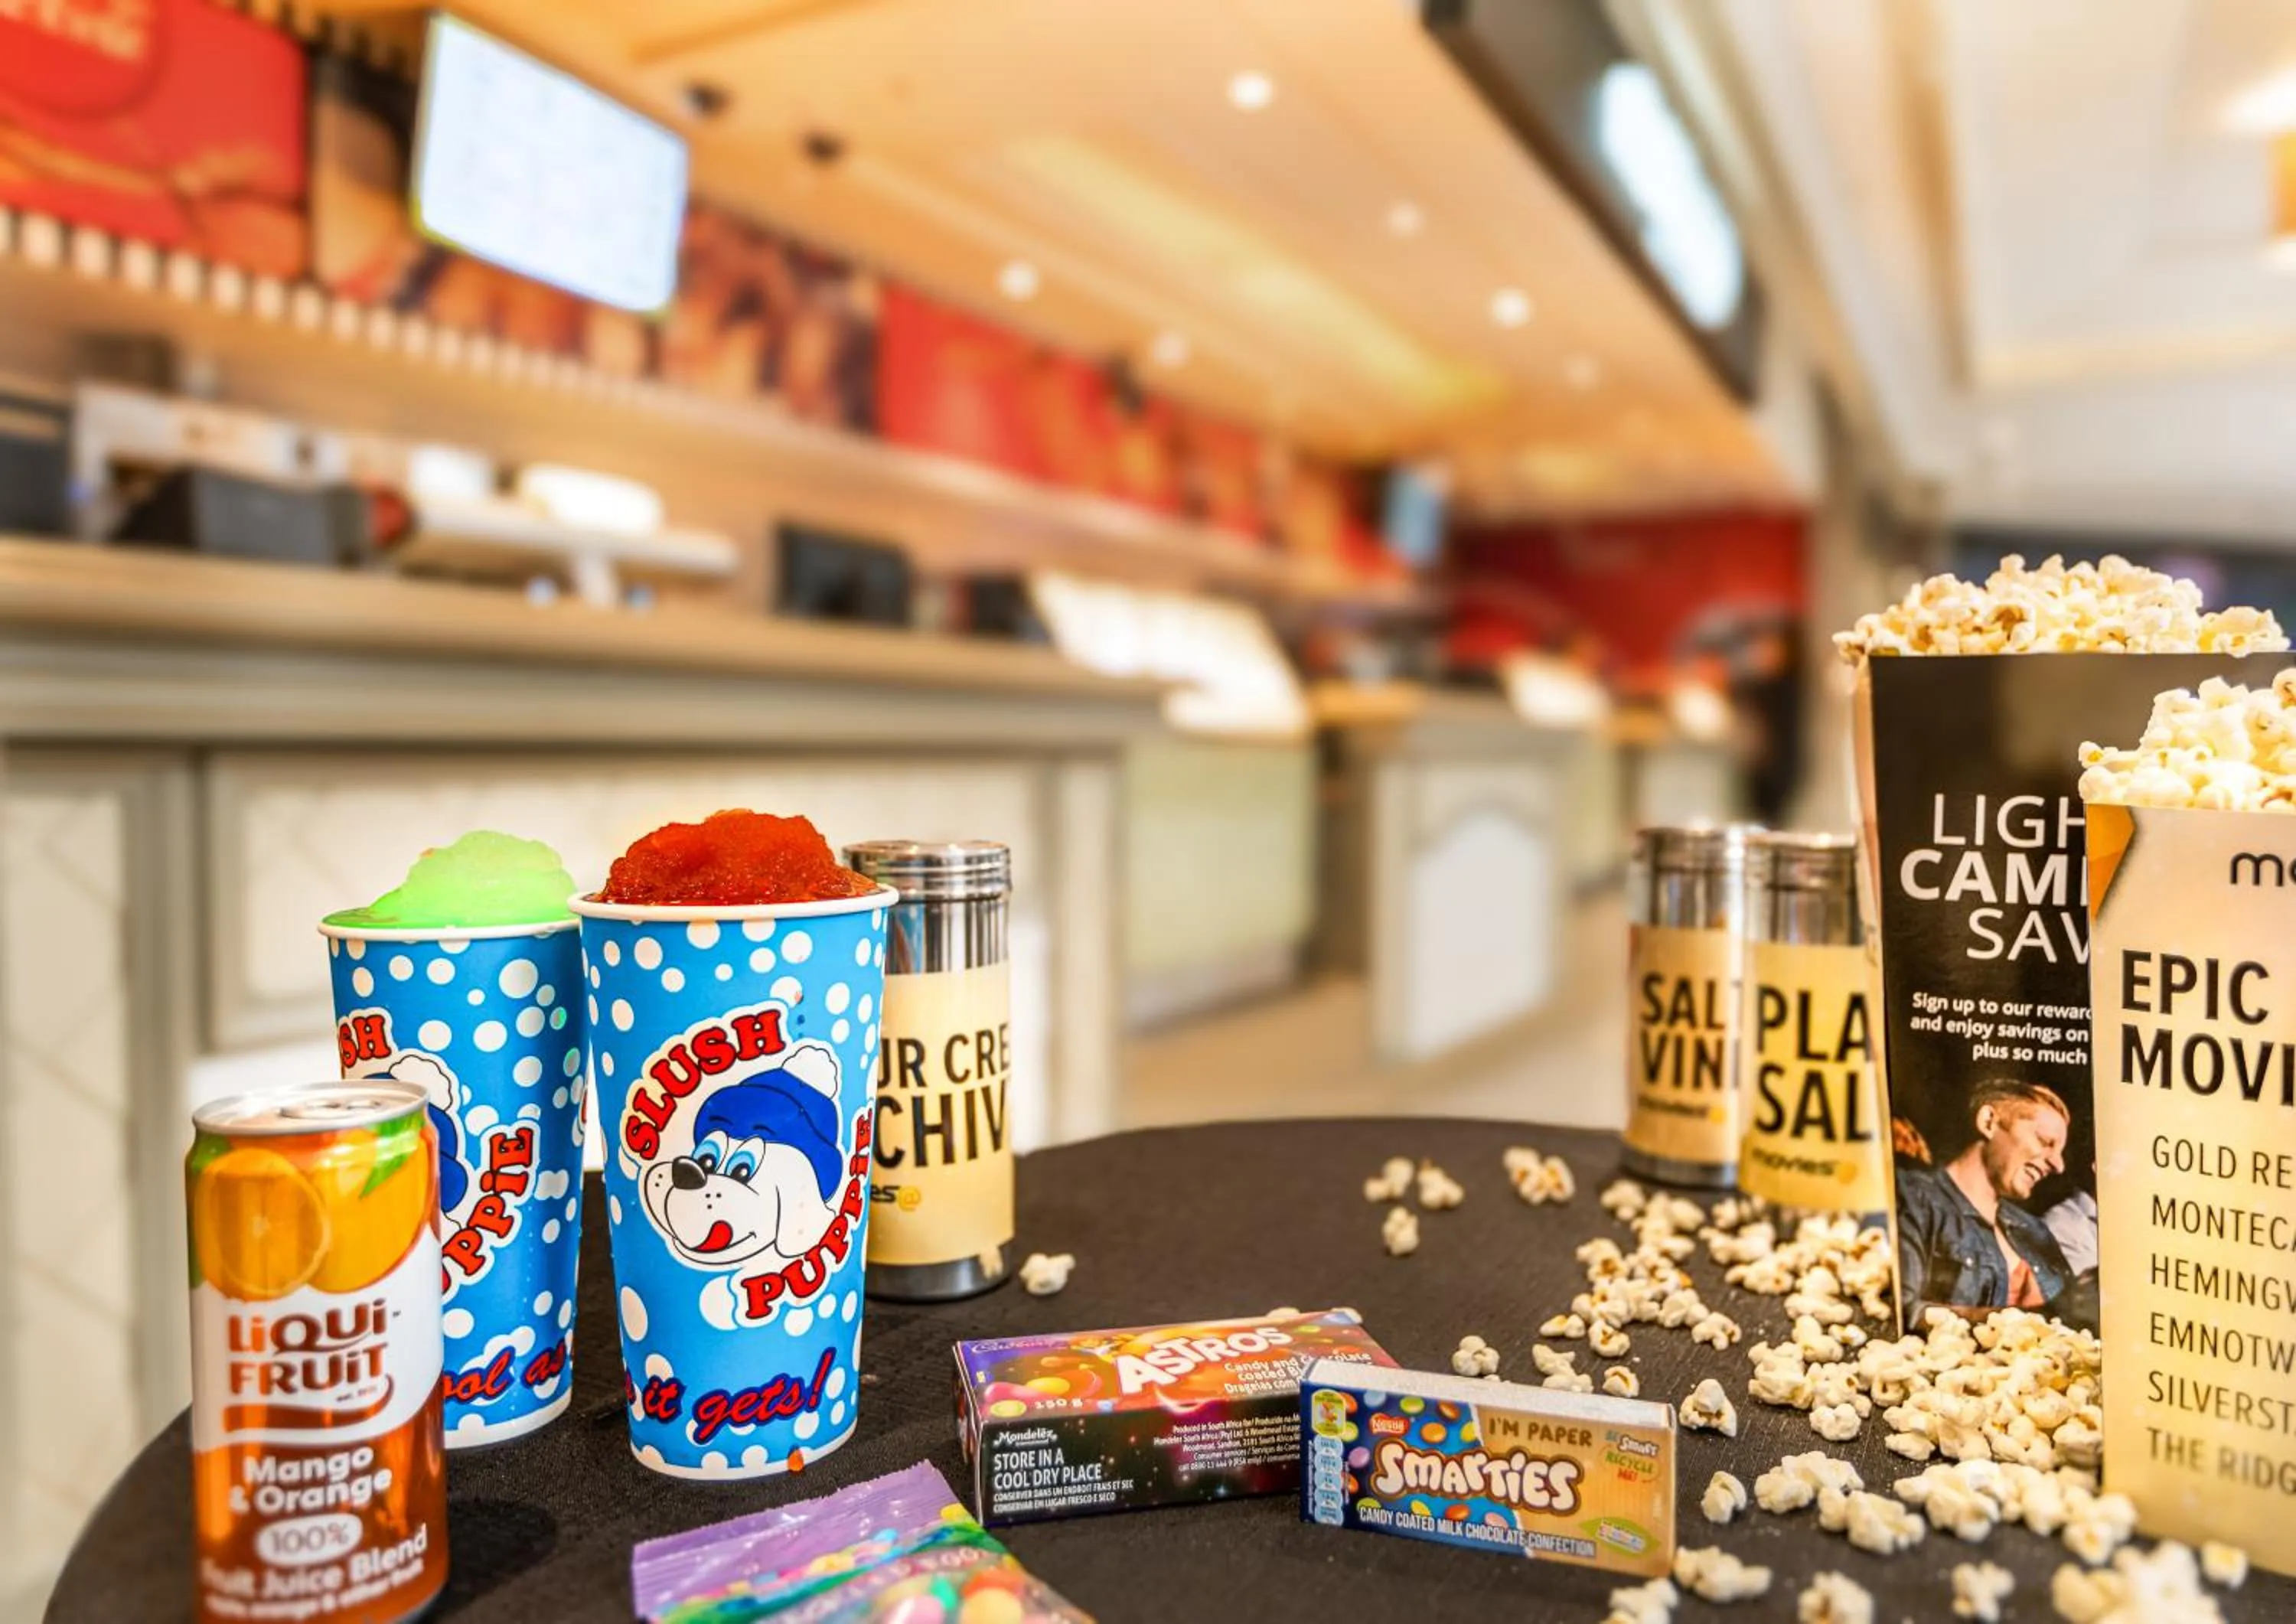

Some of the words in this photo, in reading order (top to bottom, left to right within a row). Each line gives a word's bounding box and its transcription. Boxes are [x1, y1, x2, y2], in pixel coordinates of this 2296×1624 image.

[1900, 849, 2088, 907] CAM
[1912, 992, 1949, 1014] Sign
[1953, 998, 1975, 1016] up
[1978, 998, 1998, 1015] to
[2002, 1002, 2033, 1017] our
[2122, 949, 2270, 1026] EPIC
[944, 1023, 1009, 1084] CRE
[1910, 1015, 1942, 1032] and
[1945, 1019, 1994, 1040] enjoy
[1998, 1022, 2061, 1045] savings
[2066, 1029, 2089, 1042] on
[1972, 1042, 2009, 1061] plus
[2012, 1047, 2033, 1061] so
[2037, 1047, 2088, 1065] much
[625, 1009, 785, 1161] SLUSH
[2121, 1022, 2294, 1108] MOVI
[873, 1080, 1006, 1169] CHIV
[1755, 1065, 1873, 1142] SAL
[2152, 1134, 2236, 1179] GOLD
[2252, 1150, 2293, 1190] RE
[2152, 1193, 2296, 1253] MONTEC
[1116, 1327, 1293, 1394] ASTROS
[1225, 1361, 1269, 1373] Candy
[1273, 1357, 1298, 1368] and
[2150, 1311, 2296, 1375] EMNOTW
[642, 1378, 683, 1421] it
[693, 1348, 835, 1443] gets!
[994, 1450, 1035, 1470] STORE
[1039, 1449, 1052, 1466] IN
[1055, 1447, 1064, 1465] A
[1489, 1417, 1519, 1437] I'M
[1528, 1421, 1592, 1446] PAPER
[2146, 1426, 2206, 1473] THE
[244, 1446, 373, 1484] Mango
[255, 1469, 392, 1515] Orange
[994, 1472, 1031, 1490] COOL
[1034, 1468, 1060, 1487] DRY
[1062, 1463, 1102, 1483] PLACE
[1121, 1479, 1133, 1489] SEC
[271, 1522, 349, 1554] 100%
[348, 1522, 427, 1590] Blend
[1359, 1505, 1393, 1525] CANDY
[1396, 1511, 1434, 1532] COATED
[1437, 1518, 1463, 1537] MILK
[1466, 1521, 1525, 1547] CHOCOLATE
[1528, 1531, 1594, 1557] CONFECTION
